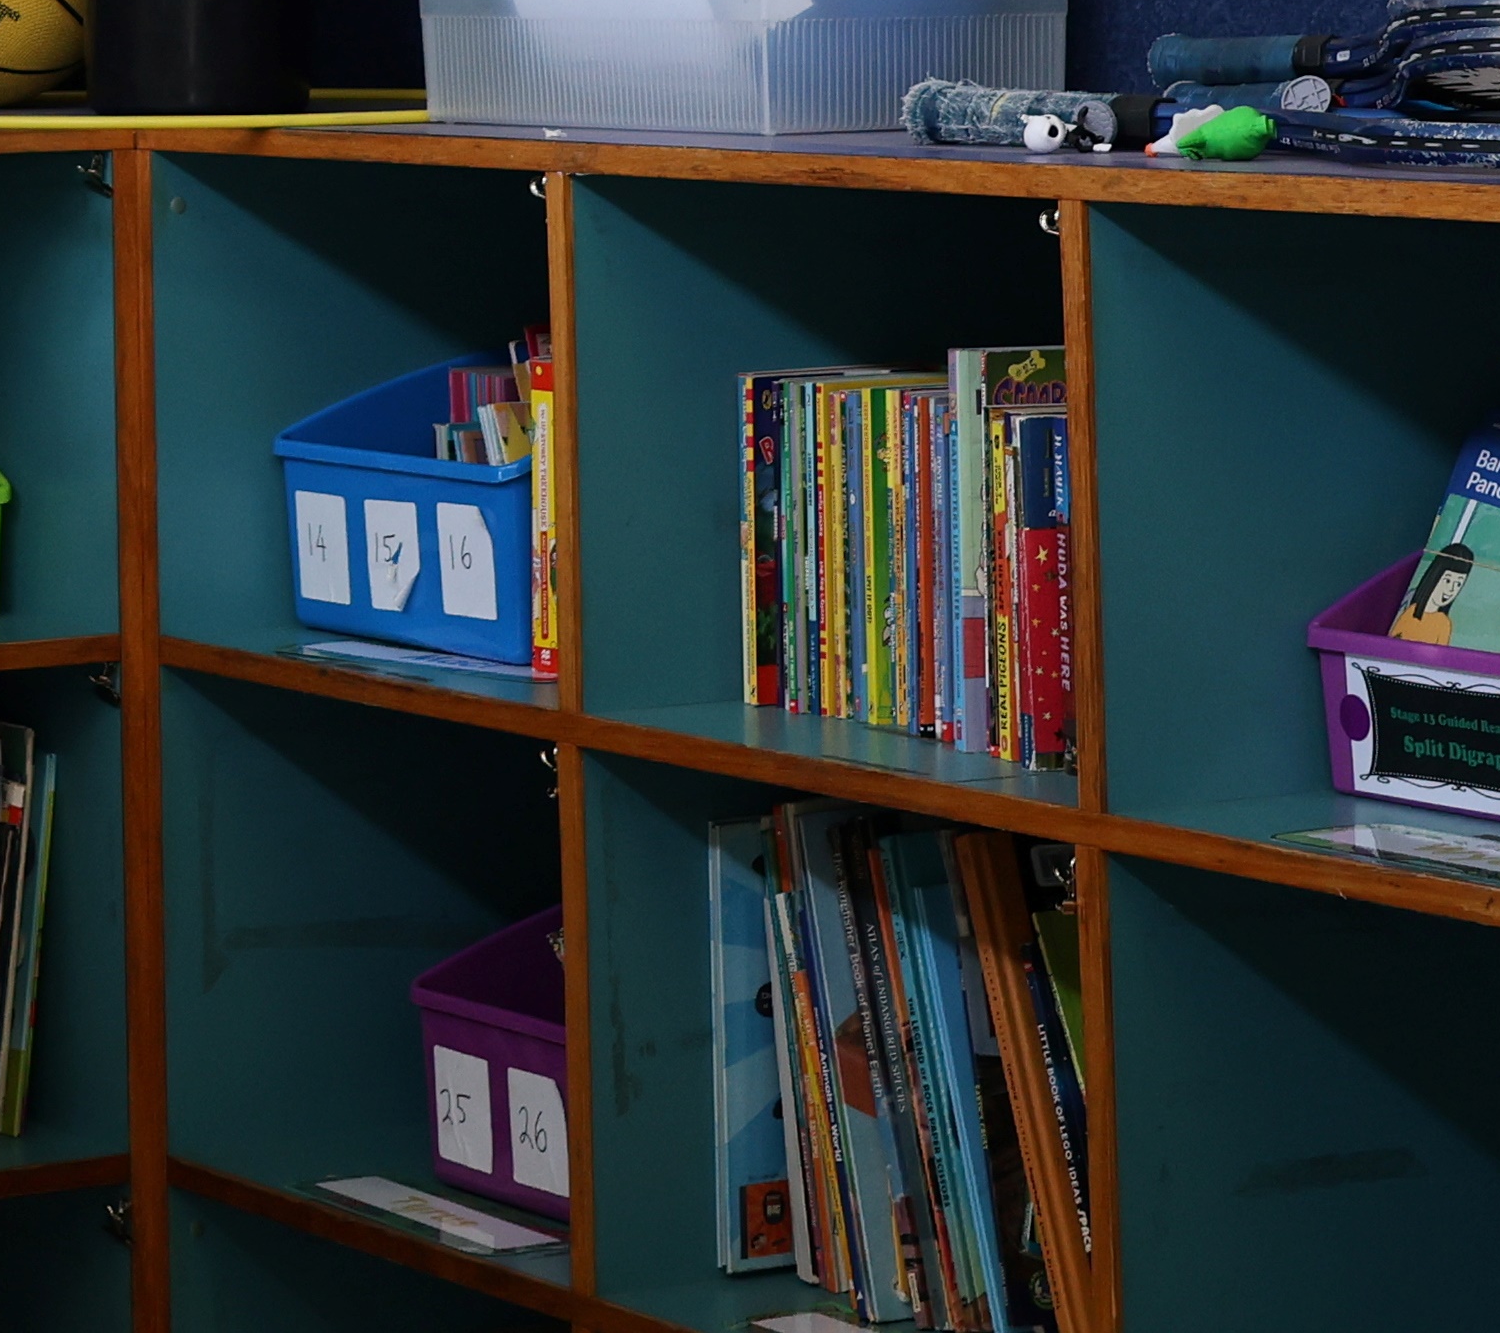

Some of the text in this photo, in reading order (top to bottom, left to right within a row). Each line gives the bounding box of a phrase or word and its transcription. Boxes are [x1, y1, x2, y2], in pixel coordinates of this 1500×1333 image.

[307, 524, 327, 563] 14
[449, 535, 473, 571] 16
[1055, 533, 1071, 691] HUDA WAS HERE
[996, 621, 1008, 731] REAL PIGEONS
[1390, 706, 1420, 723] Stage
[1438, 713, 1479, 731] Guided
[1403, 735, 1445, 759] Split
[850, 953, 886, 1098] Book Planet Earth
[874, 979, 908, 1113] ENDANGERED SPECIES
[911, 1020, 926, 1065] LEGEND
[440, 1089, 471, 1125] 25
[518, 1106, 548, 1153] 26
[818, 1051, 845, 1162] Animals World
[1036, 1023, 1084, 1204] LITTLE BOOK IDEAS
